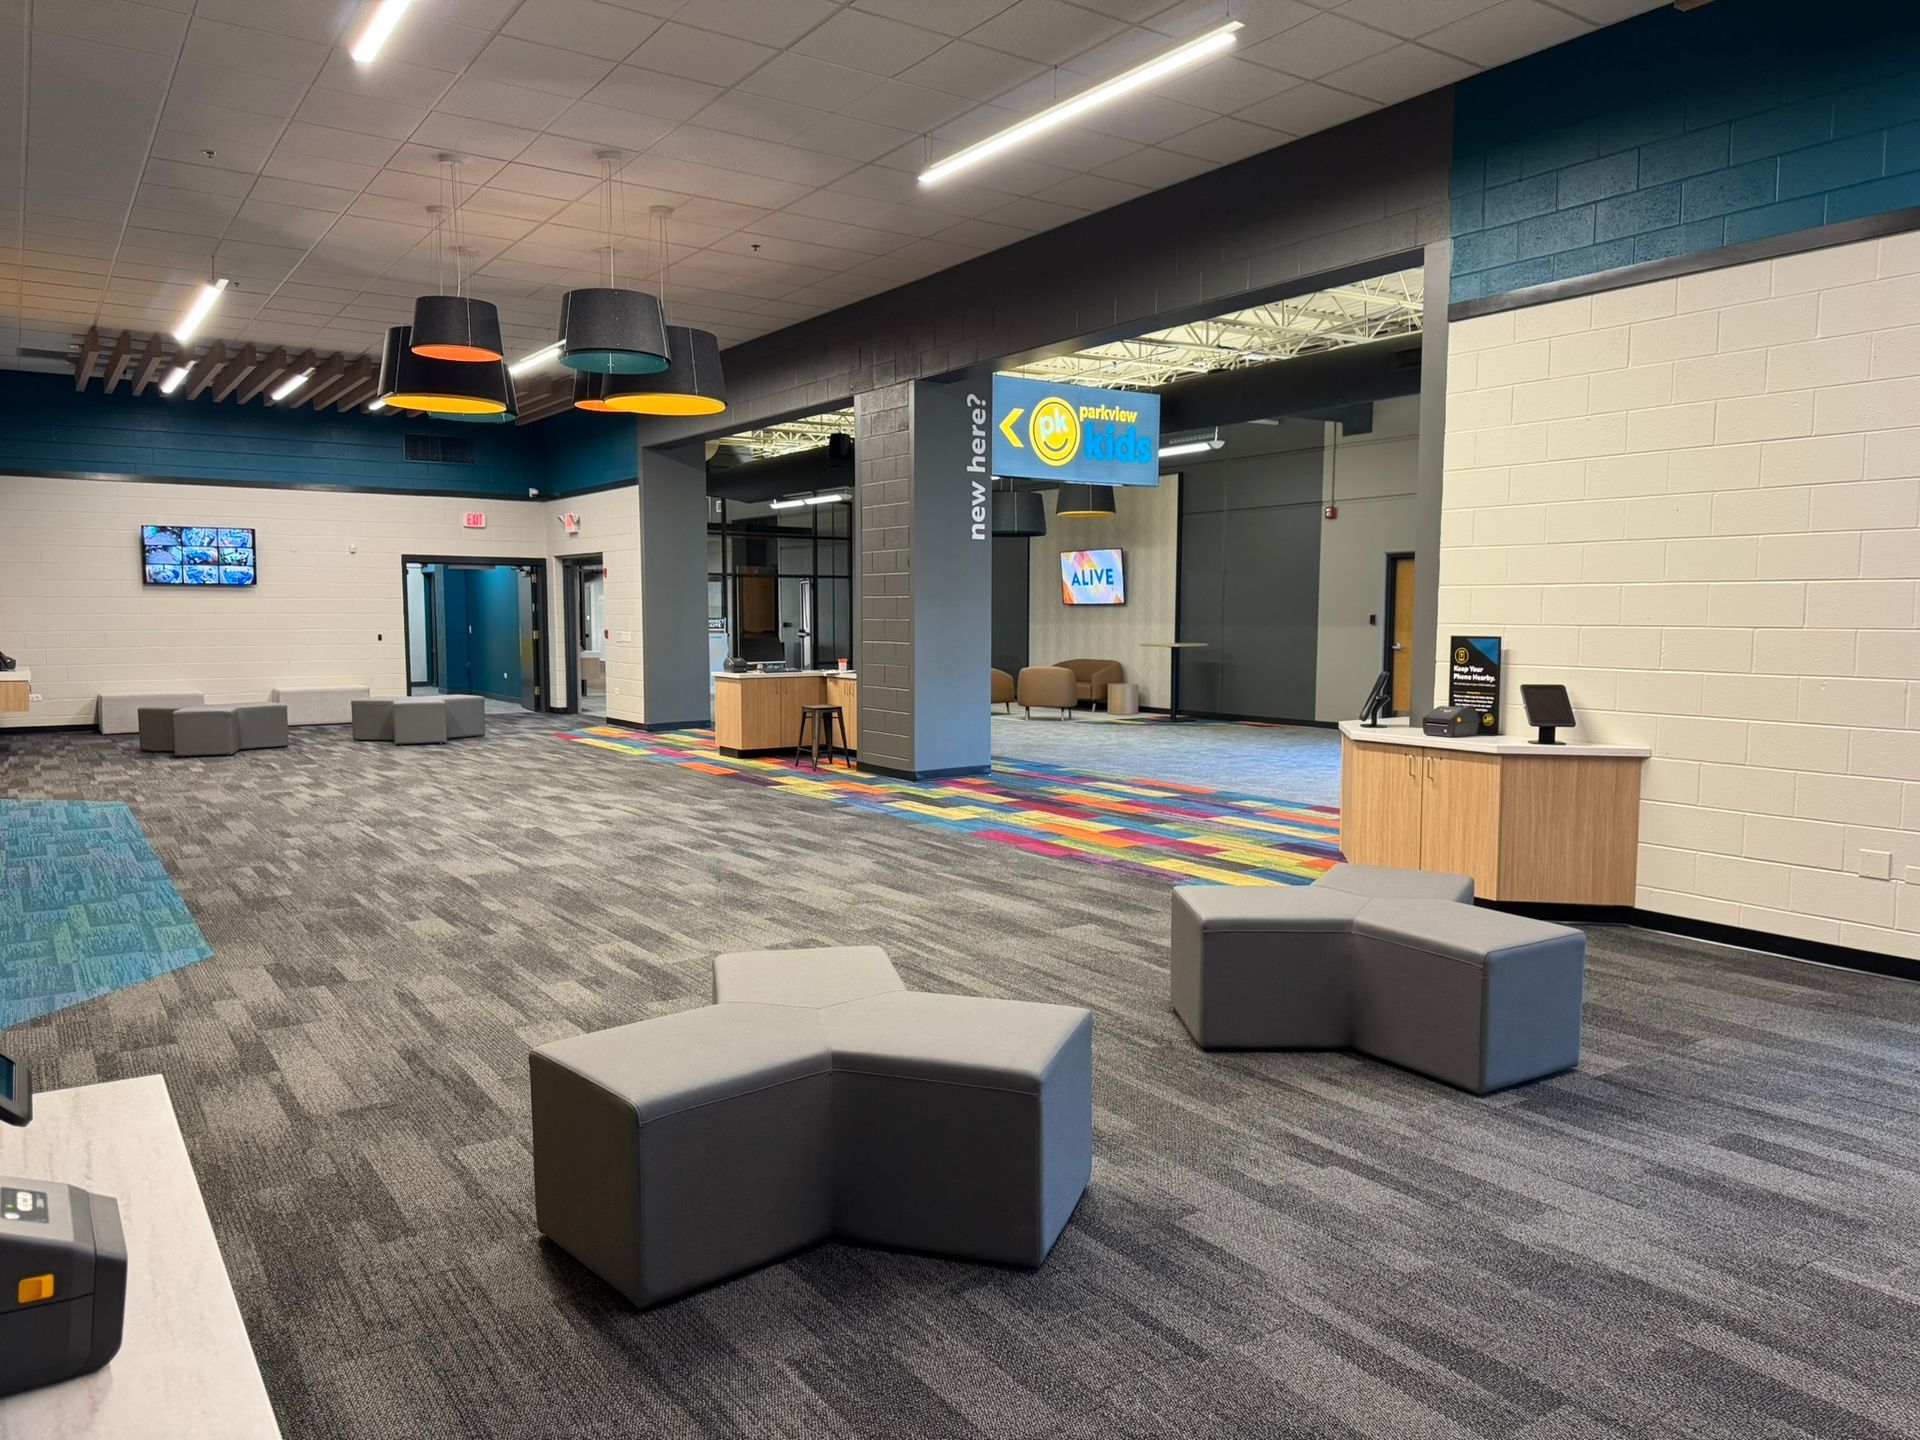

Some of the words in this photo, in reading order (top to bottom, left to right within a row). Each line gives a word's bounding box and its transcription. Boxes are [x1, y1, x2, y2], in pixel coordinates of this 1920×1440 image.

[1038, 407, 1068, 441] pk
[1079, 405, 1138, 424] parkview
[967, 393, 986, 473] here?
[1083, 421, 1152, 464] kids
[467, 514, 483, 526] EXIT
[971, 481, 986, 540] new
[1071, 568, 1115, 586] ALIVE
[1453, 665, 1469, 674] Keep
[1469, 665, 1484, 673] Your
[1472, 674, 1496, 683] Nearby.
